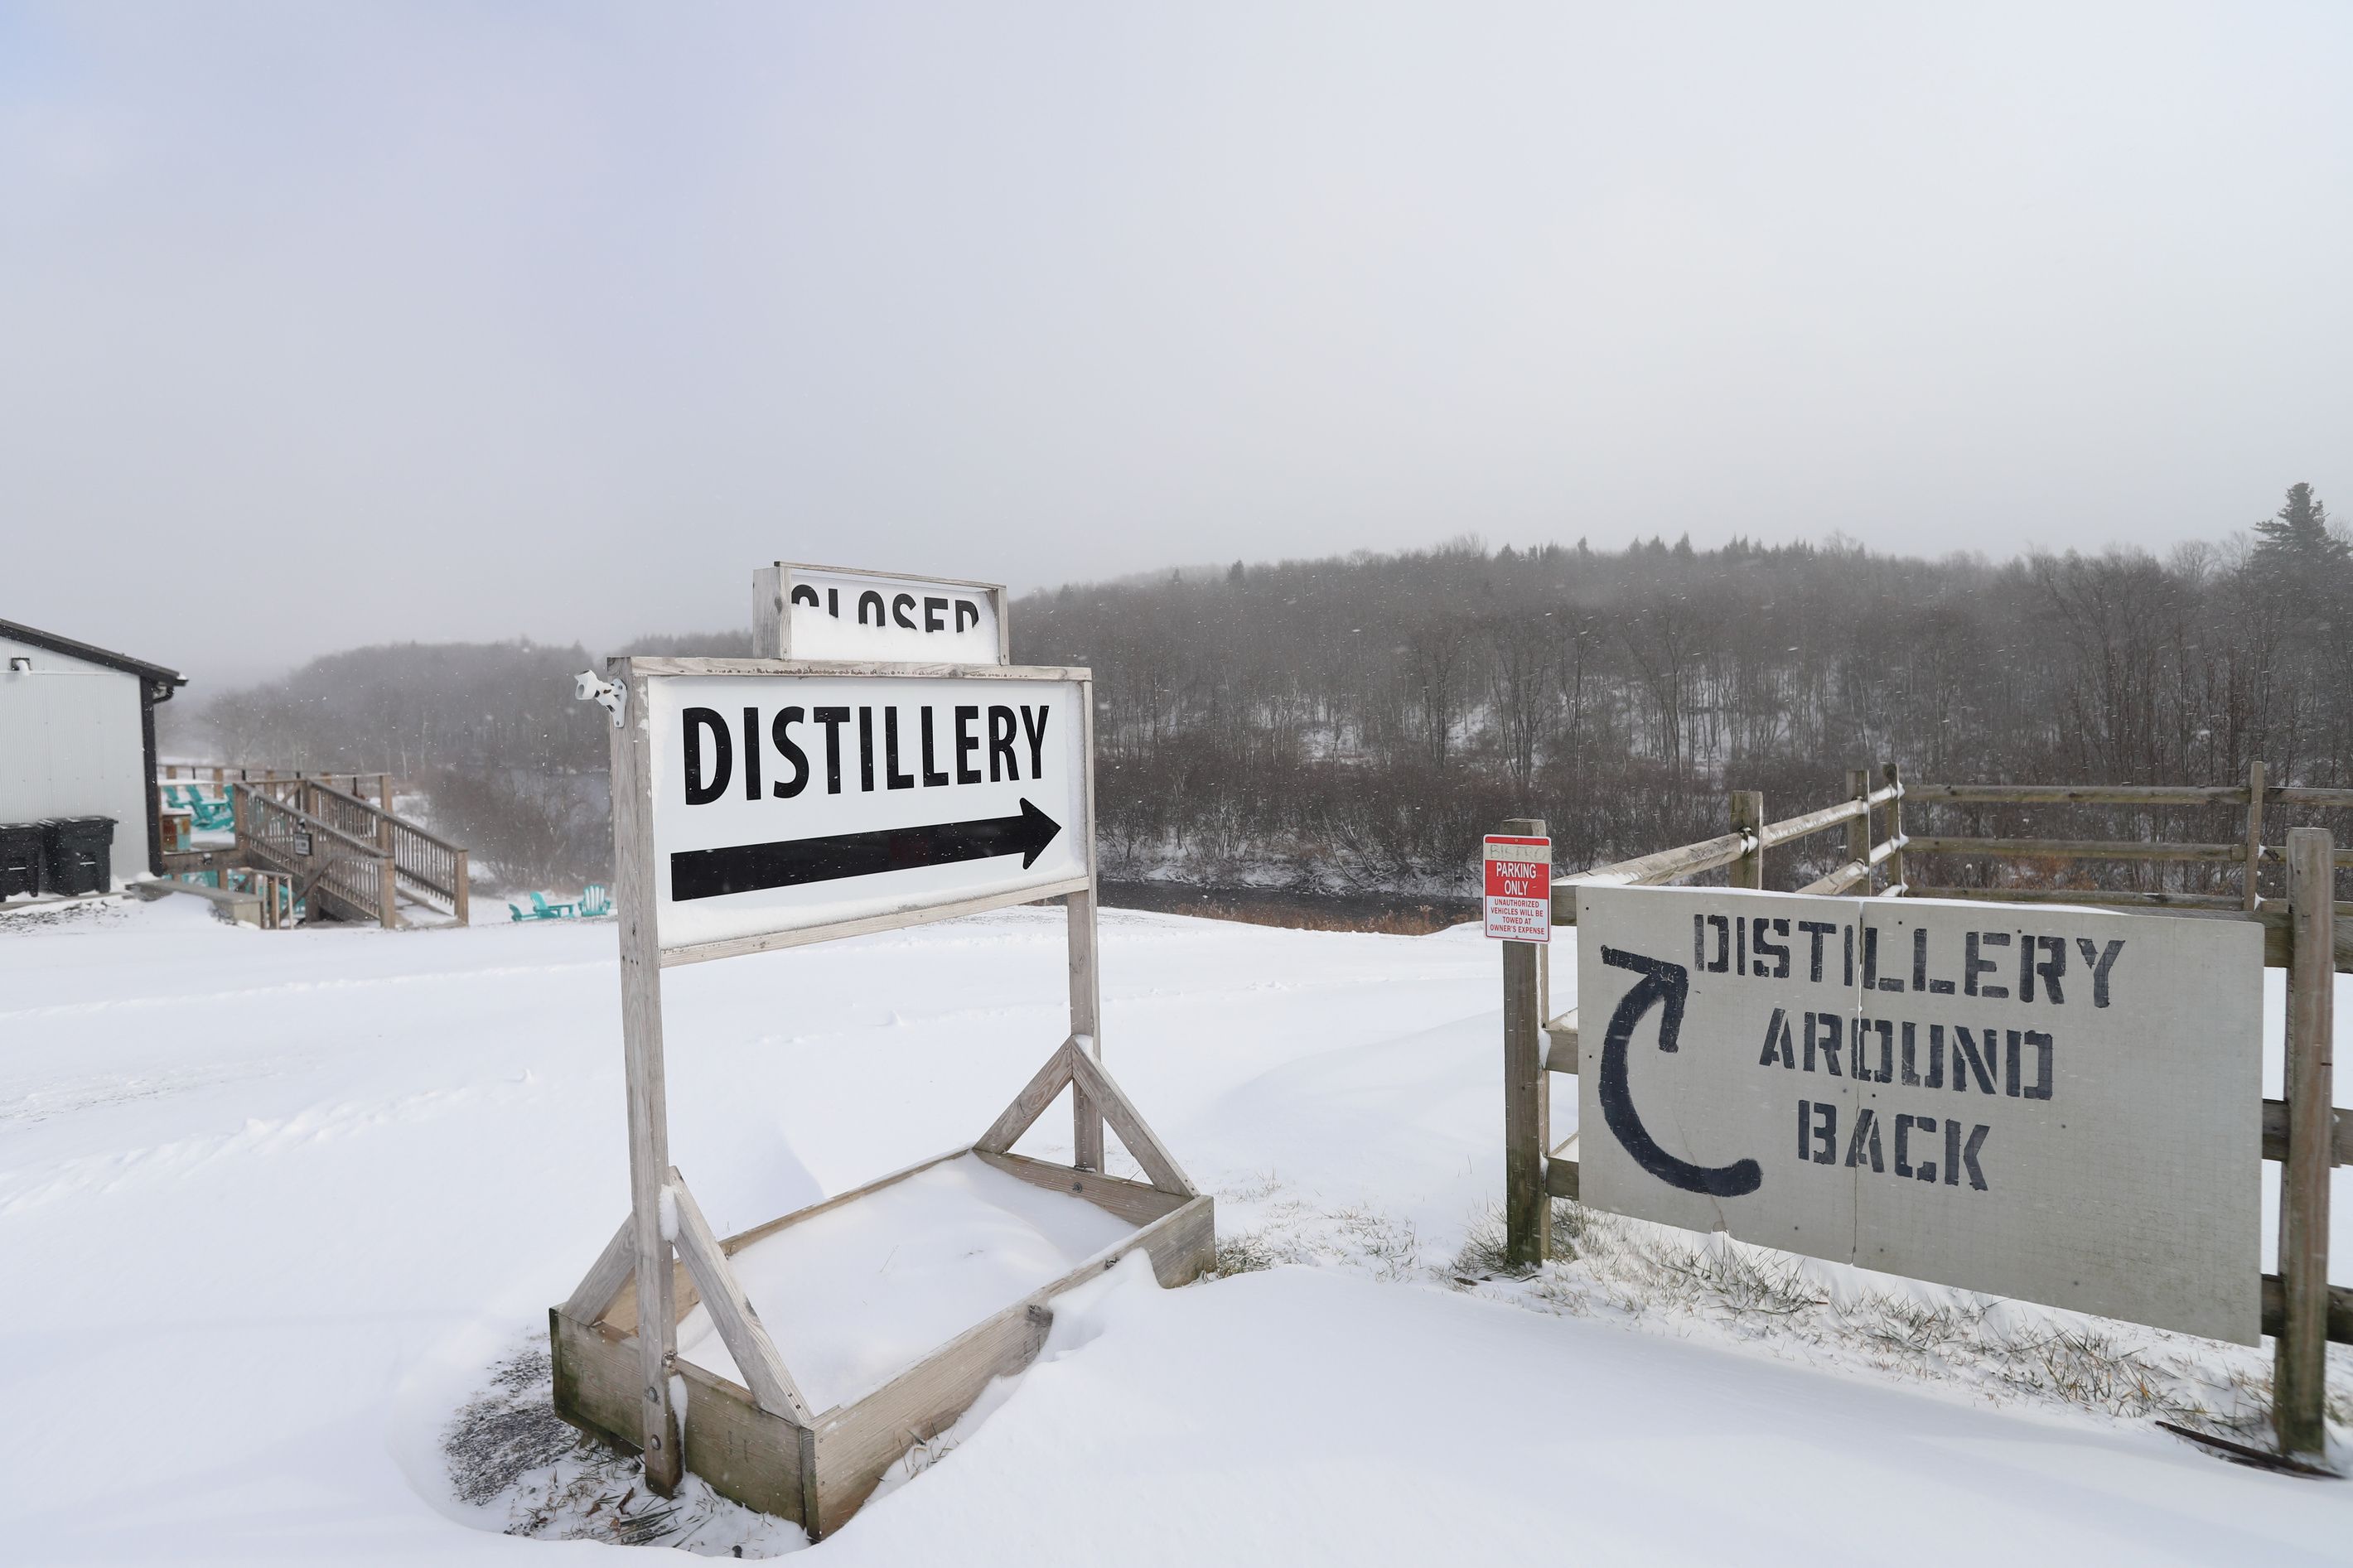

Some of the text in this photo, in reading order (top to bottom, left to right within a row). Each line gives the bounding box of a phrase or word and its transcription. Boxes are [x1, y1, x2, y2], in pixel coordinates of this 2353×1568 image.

[683, 706, 1050, 806] DISTILLERY
[1491, 845, 1546, 861] BISTRO
[1496, 862, 1537, 879] PARKING
[1504, 880, 1529, 896] ONLY
[1491, 907, 1519, 915] VEHICLES
[1495, 899, 1539, 908] UNAUTHORIZED
[1490, 924, 1545, 935] OWNER'S EXPENSE
[1694, 914, 2126, 1009] DISTILLERY
[1759, 1007, 2054, 1101] AROUND
[1798, 1099, 1991, 1192] BACK
